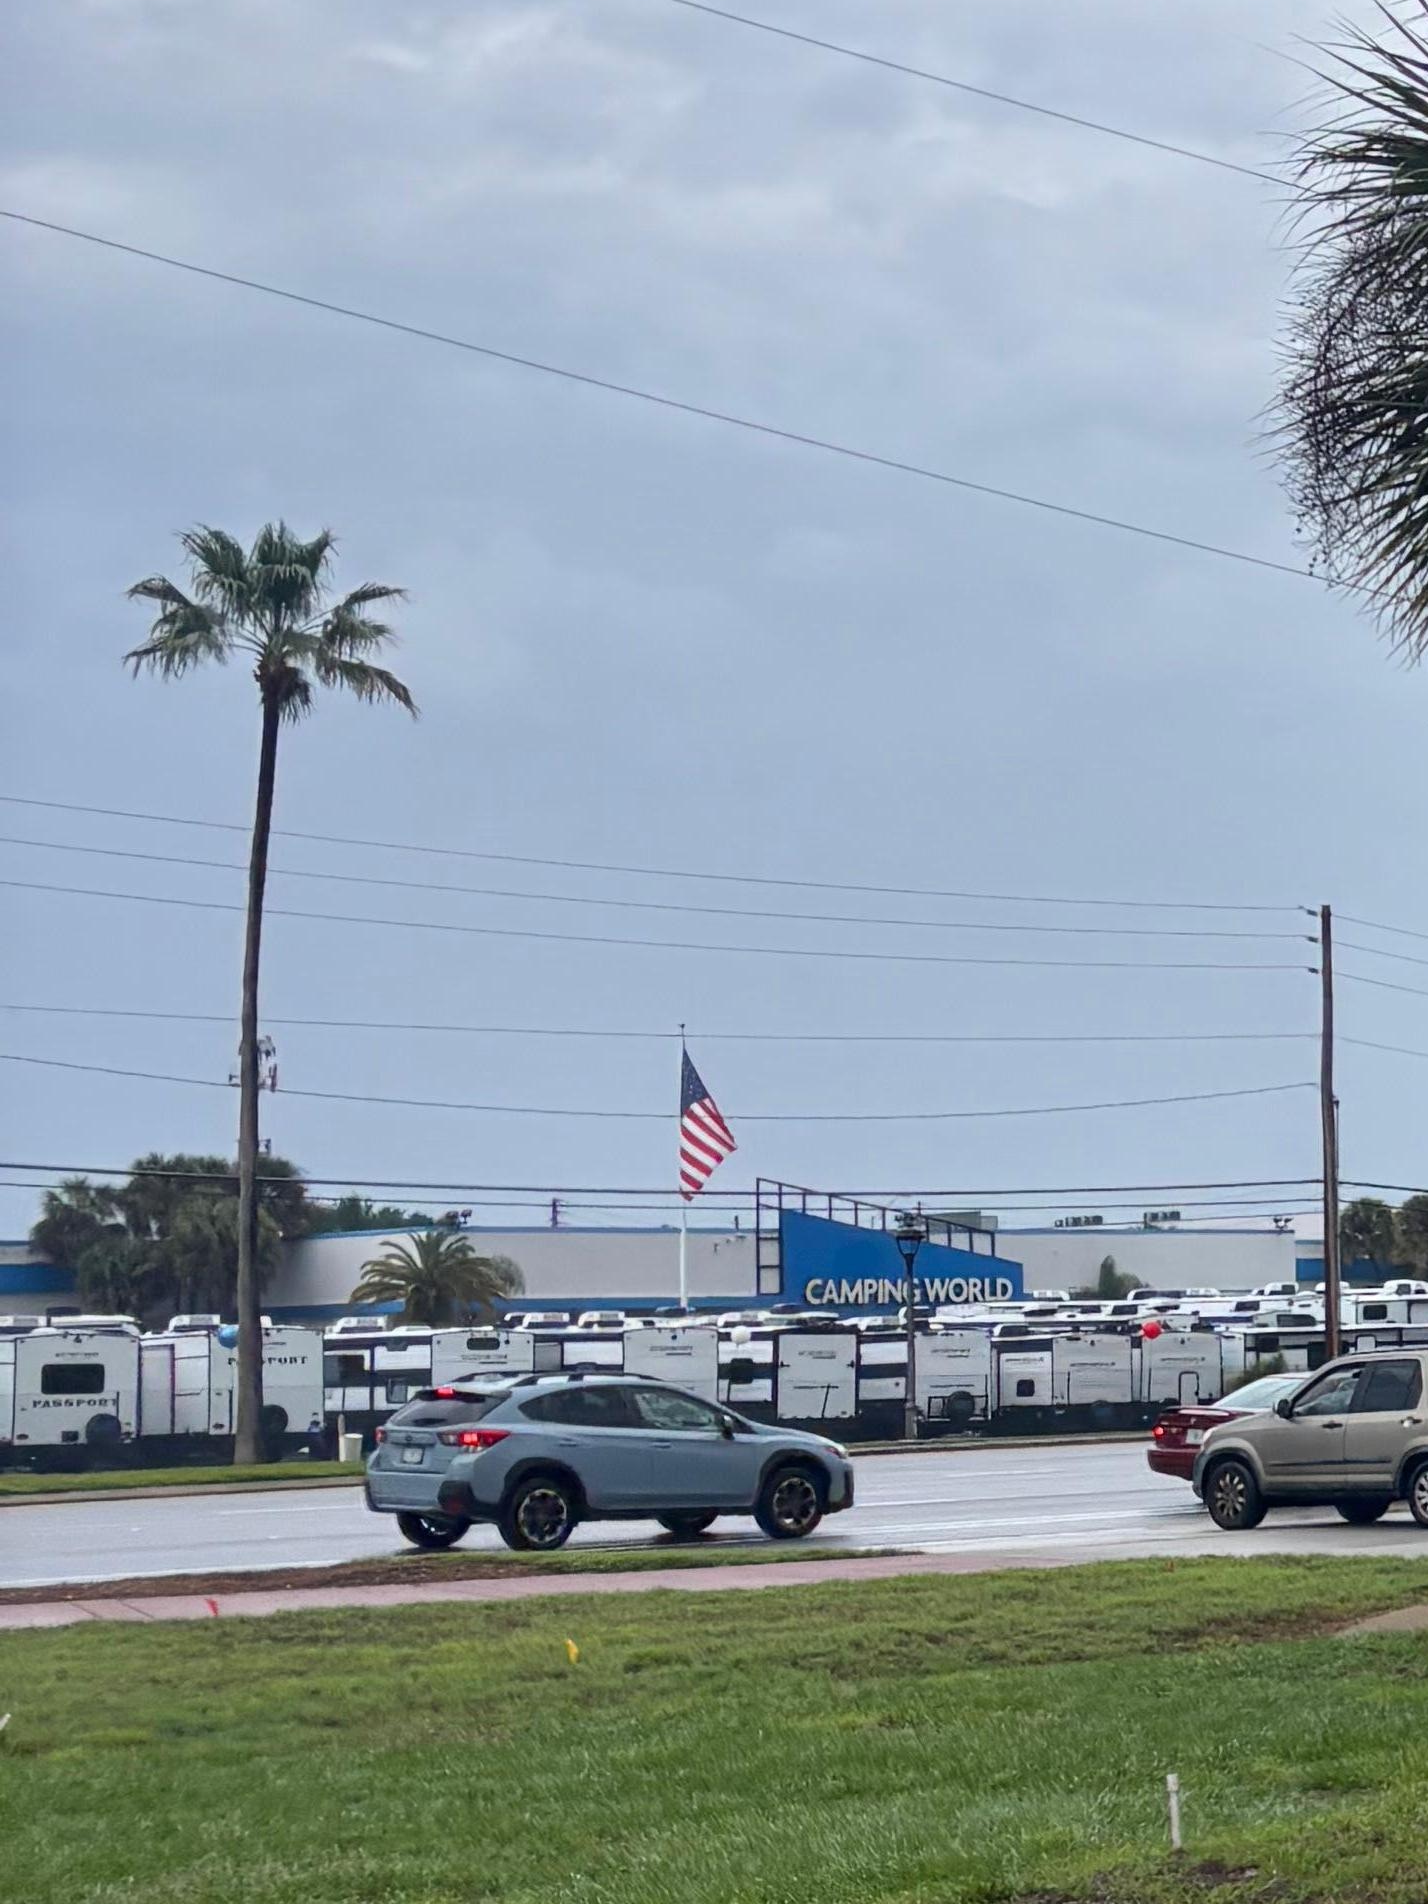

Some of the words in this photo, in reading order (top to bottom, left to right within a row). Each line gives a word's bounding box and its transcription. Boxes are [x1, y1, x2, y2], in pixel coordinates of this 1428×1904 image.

[805, 1278, 921, 1305] CAMPING
[924, 1277, 1014, 1302] WORLD
[227, 1355, 308, 1366] PPORT
